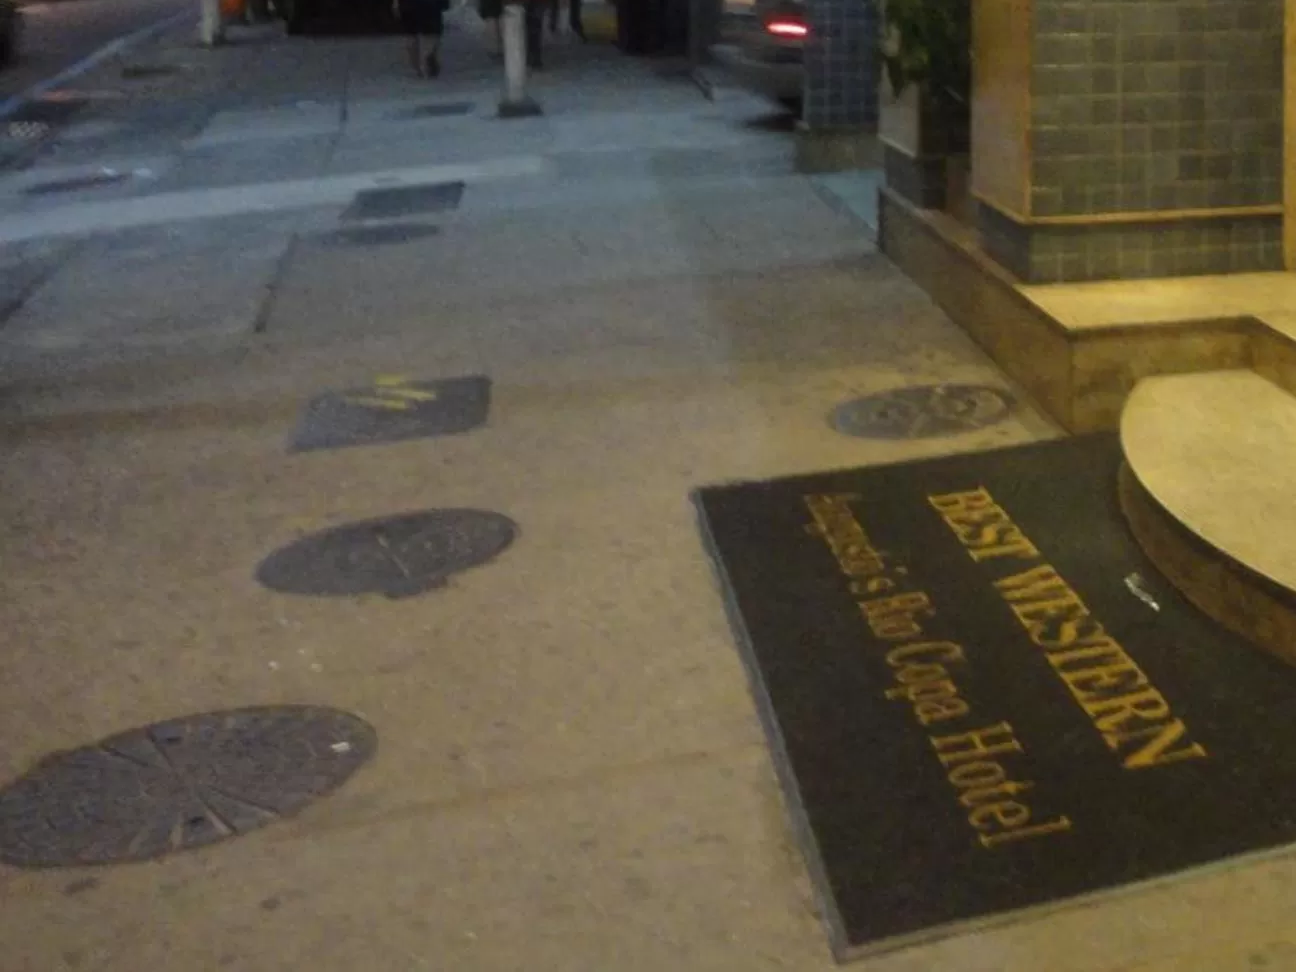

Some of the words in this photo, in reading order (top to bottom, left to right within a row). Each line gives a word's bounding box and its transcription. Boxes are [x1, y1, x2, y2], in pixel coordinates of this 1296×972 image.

[885, 641, 969, 726] Copa
[930, 721, 1071, 850] Hotel
[927, 485, 1041, 564] BEST
[993, 563, 1207, 770] WESTERN
